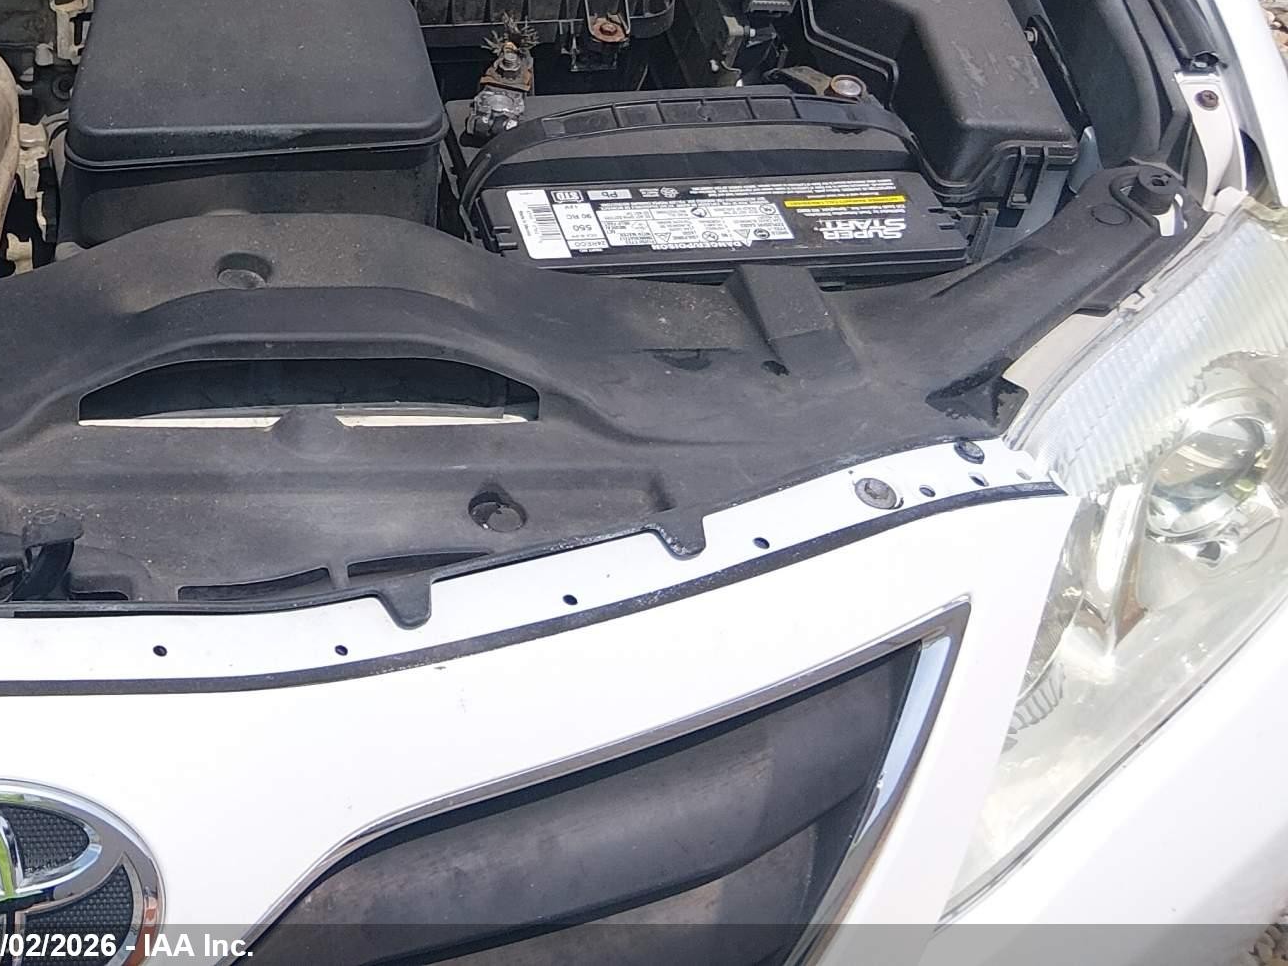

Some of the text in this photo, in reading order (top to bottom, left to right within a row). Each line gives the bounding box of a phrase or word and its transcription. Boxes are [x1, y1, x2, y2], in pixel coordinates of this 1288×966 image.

[601, 191, 619, 199] Pb
[822, 219, 906, 231] START
[822, 230, 903, 240] SUPER
